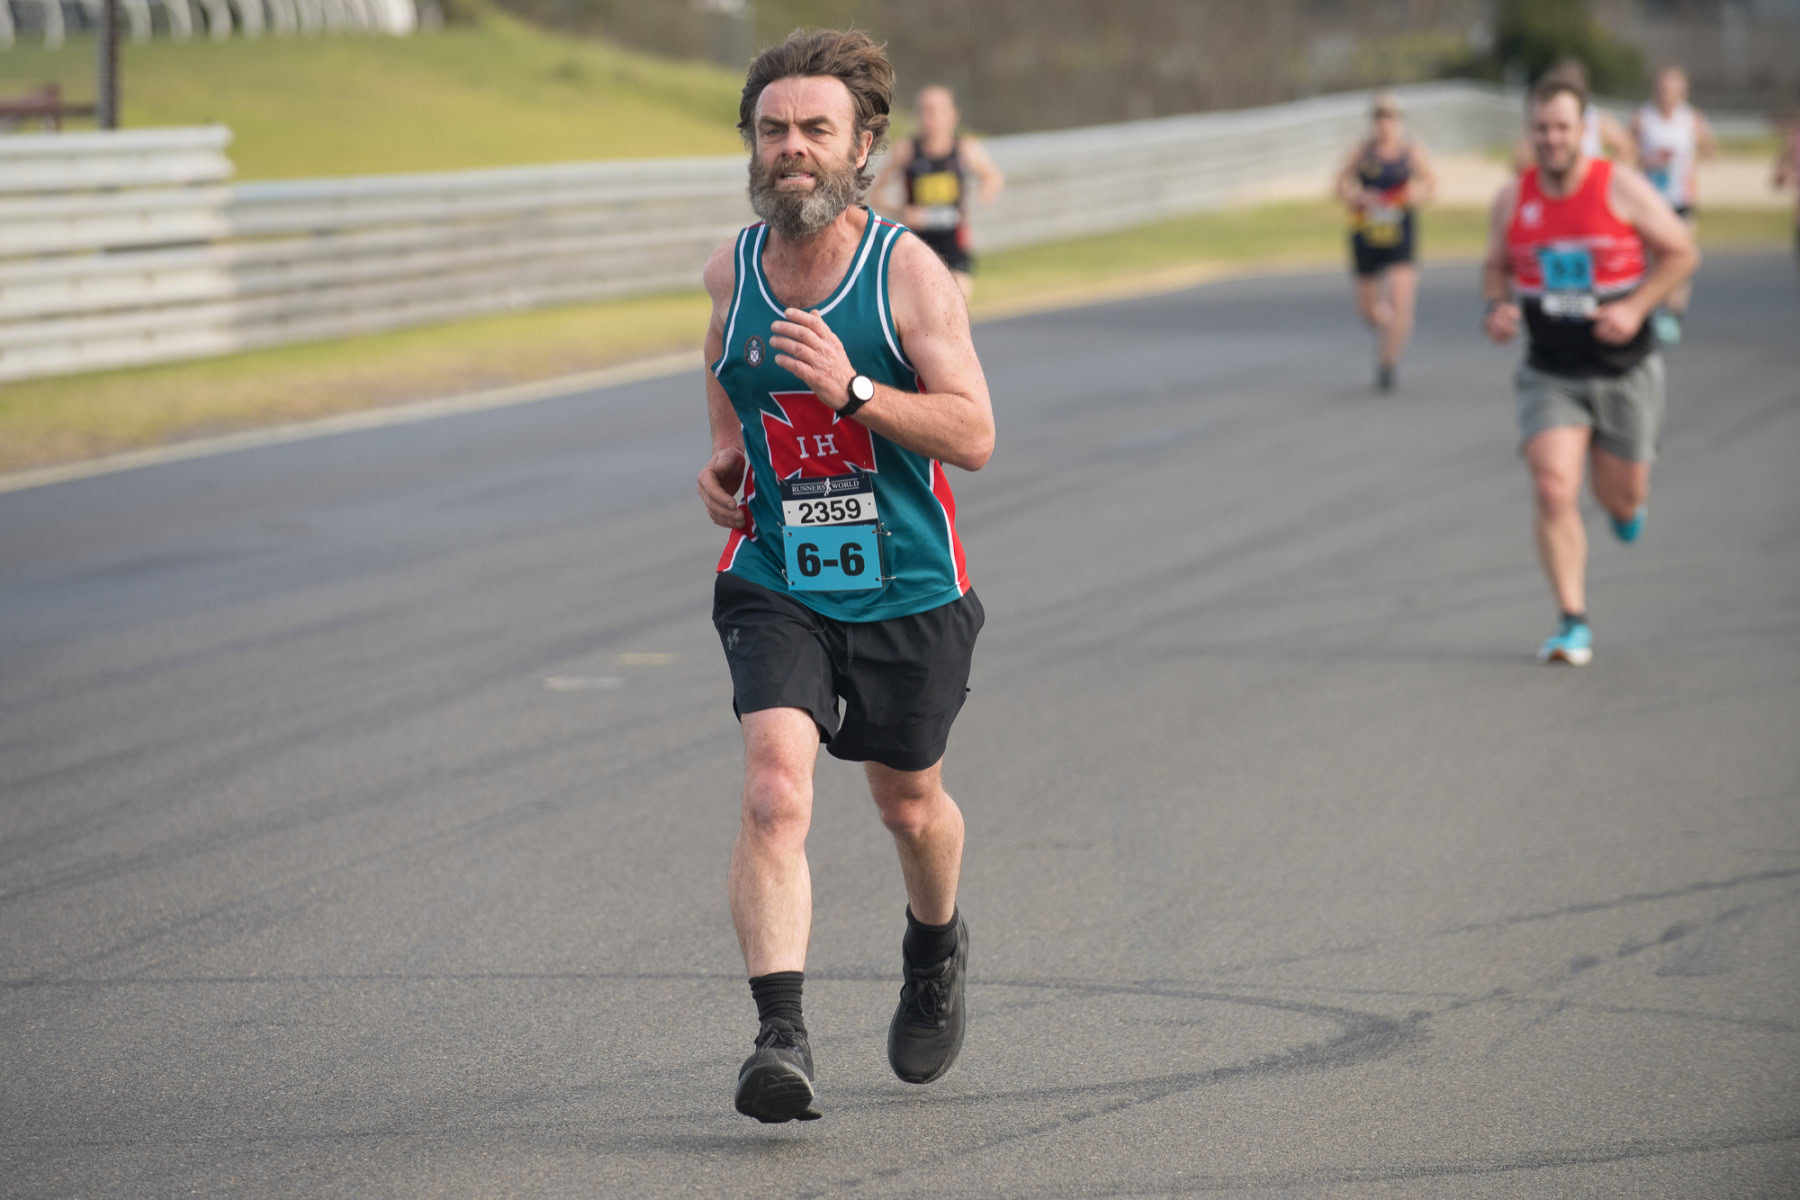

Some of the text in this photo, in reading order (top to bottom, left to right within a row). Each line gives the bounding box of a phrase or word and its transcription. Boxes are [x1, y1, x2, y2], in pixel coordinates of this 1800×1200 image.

[831, 480, 860, 489] WORLD
[798, 498, 862, 524] 2359
[796, 542, 865, 577] 6-6
